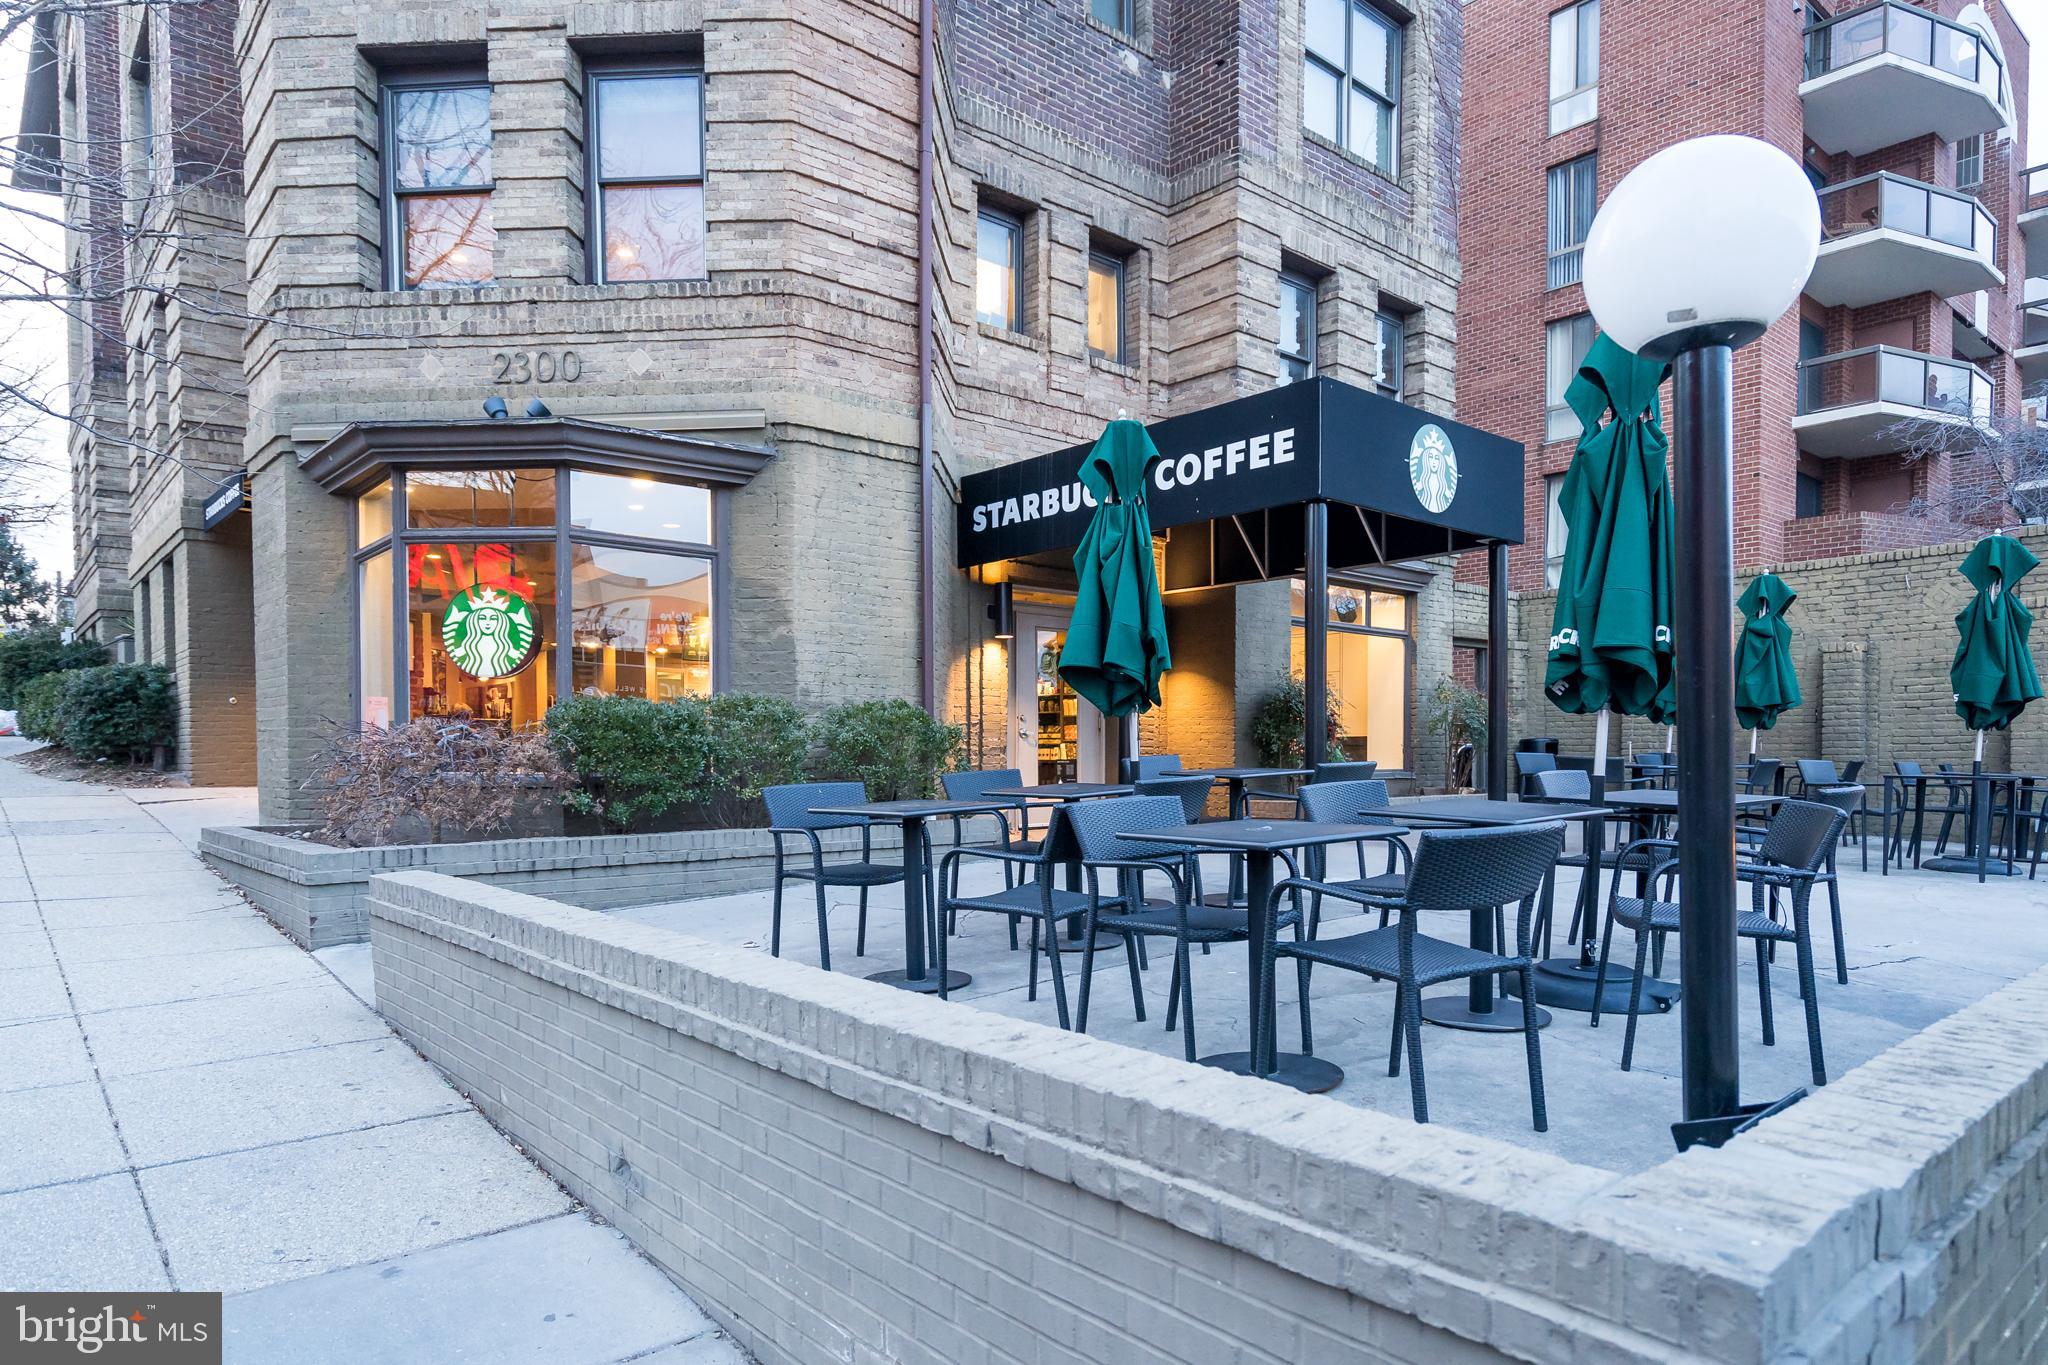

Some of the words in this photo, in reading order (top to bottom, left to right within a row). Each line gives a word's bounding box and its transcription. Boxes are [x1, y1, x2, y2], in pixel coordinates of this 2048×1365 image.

[493, 351, 582, 384] 2300
[972, 481, 1099, 533] STARBUC
[1154, 427, 1295, 491] COFFEE
